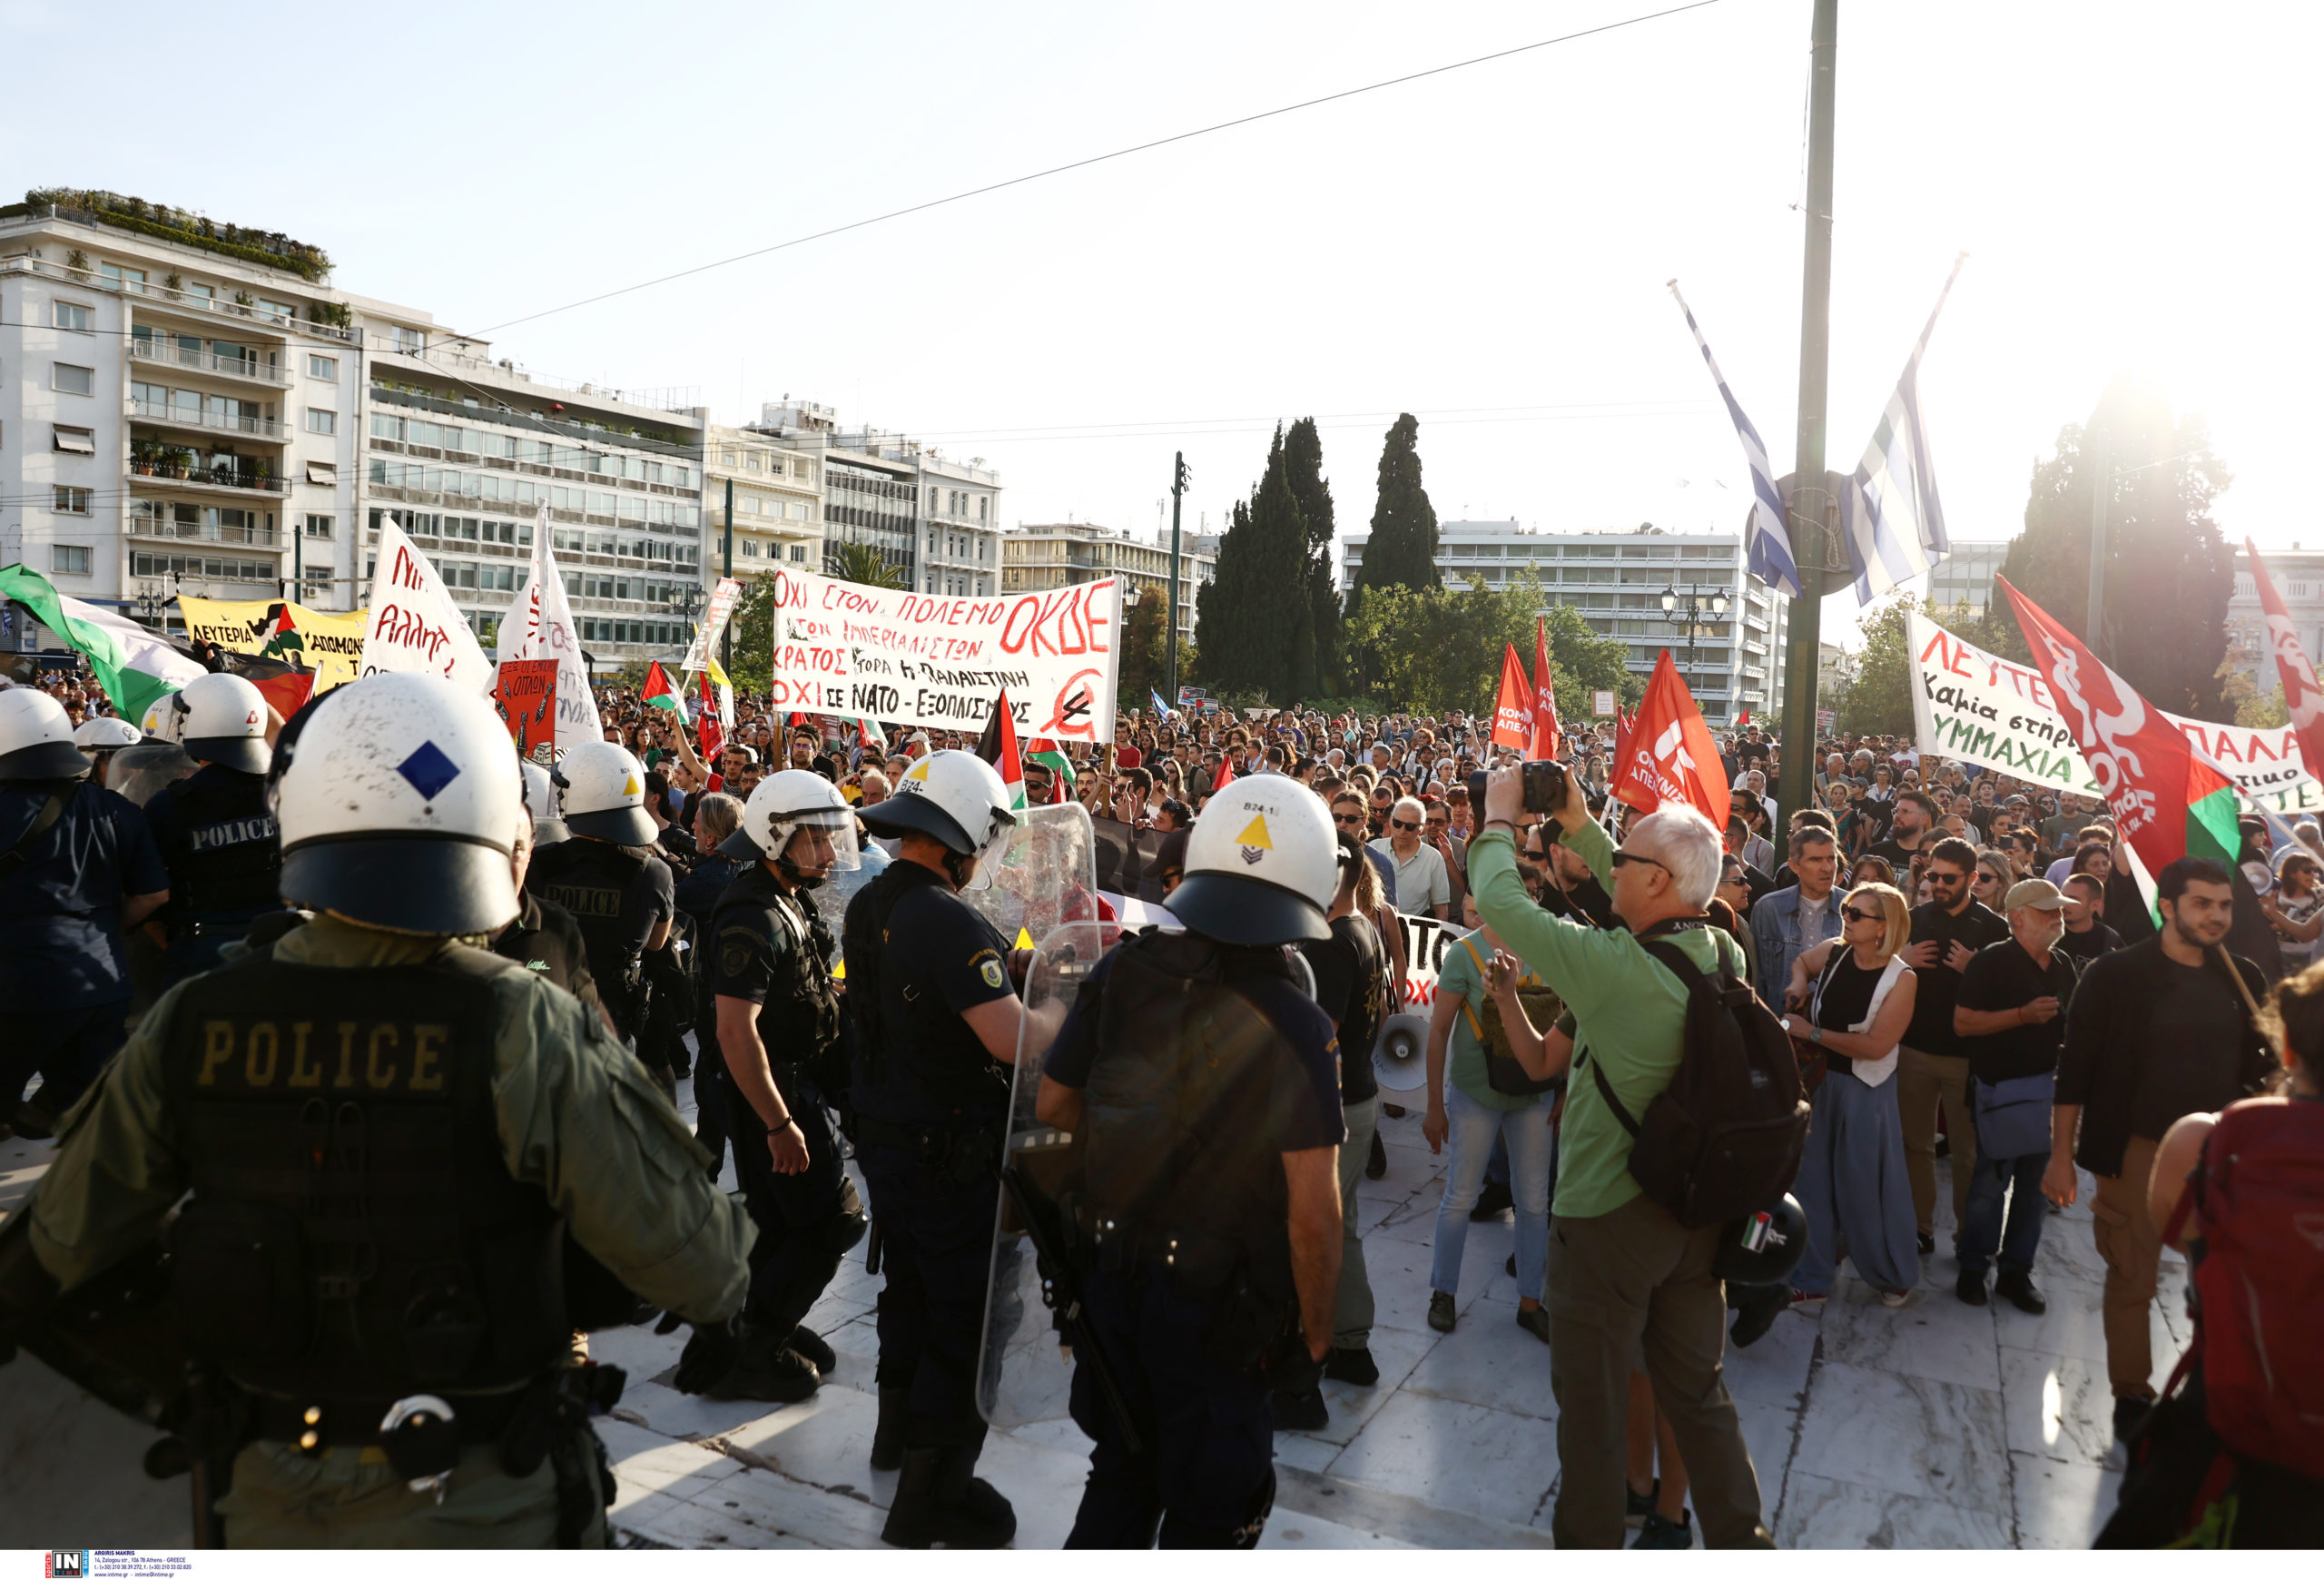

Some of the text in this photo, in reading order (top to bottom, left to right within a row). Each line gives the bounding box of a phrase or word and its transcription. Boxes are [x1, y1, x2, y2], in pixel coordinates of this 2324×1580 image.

[773, 570, 808, 609] ΟΧΙ
[822, 584, 879, 614] ΣΤΟΝ
[896, 595, 1005, 626] ΠΟΛΕΜΟ
[1000, 579, 1116, 657] ΟΚΔΕ
[193, 624, 254, 644] ΛΕΥΤΕΡΙΑ
[1920, 629, 2061, 715] ΛΕΥΤΕ
[772, 678, 822, 707] ΟΧΙ
[826, 688, 844, 708] ΣΕ
[852, 683, 900, 715] ΝΑΤΟ
[917, 688, 1032, 724] ΕΞΟΠΛΙΣΜΥΣ
[192, 817, 274, 851] POLICE
[548, 885, 618, 914] POLICE
[198, 1020, 448, 1091] POLICE
